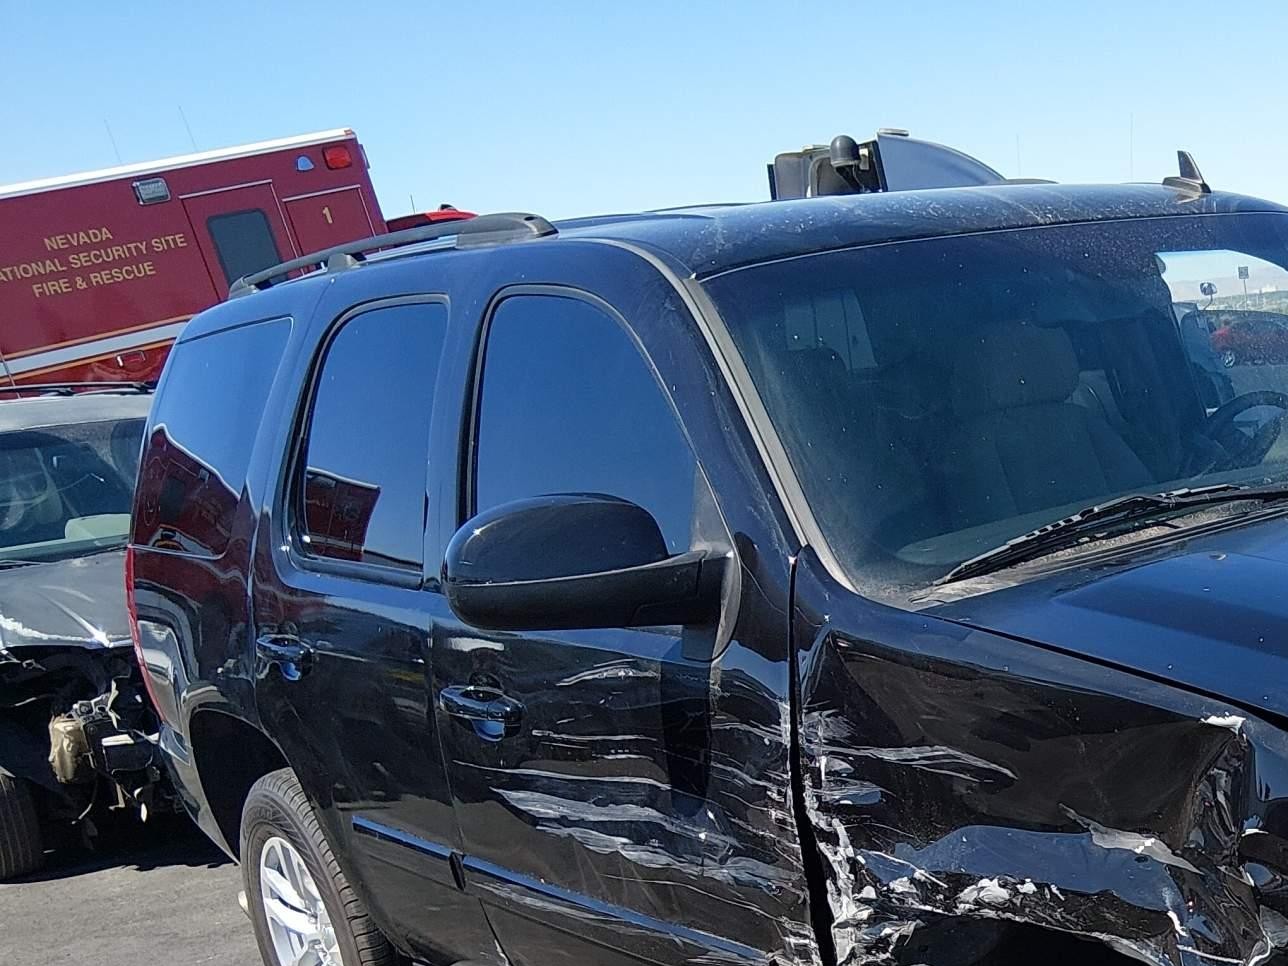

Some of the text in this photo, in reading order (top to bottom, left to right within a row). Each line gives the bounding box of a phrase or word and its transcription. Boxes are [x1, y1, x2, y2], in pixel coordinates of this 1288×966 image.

[322, 206, 333, 224] 1
[44, 227, 113, 251] NEVADA
[69, 241, 147, 269] SECURITY
[151, 233, 188, 252] SITE
[32, 261, 157, 298] FIRE & RESCUE
